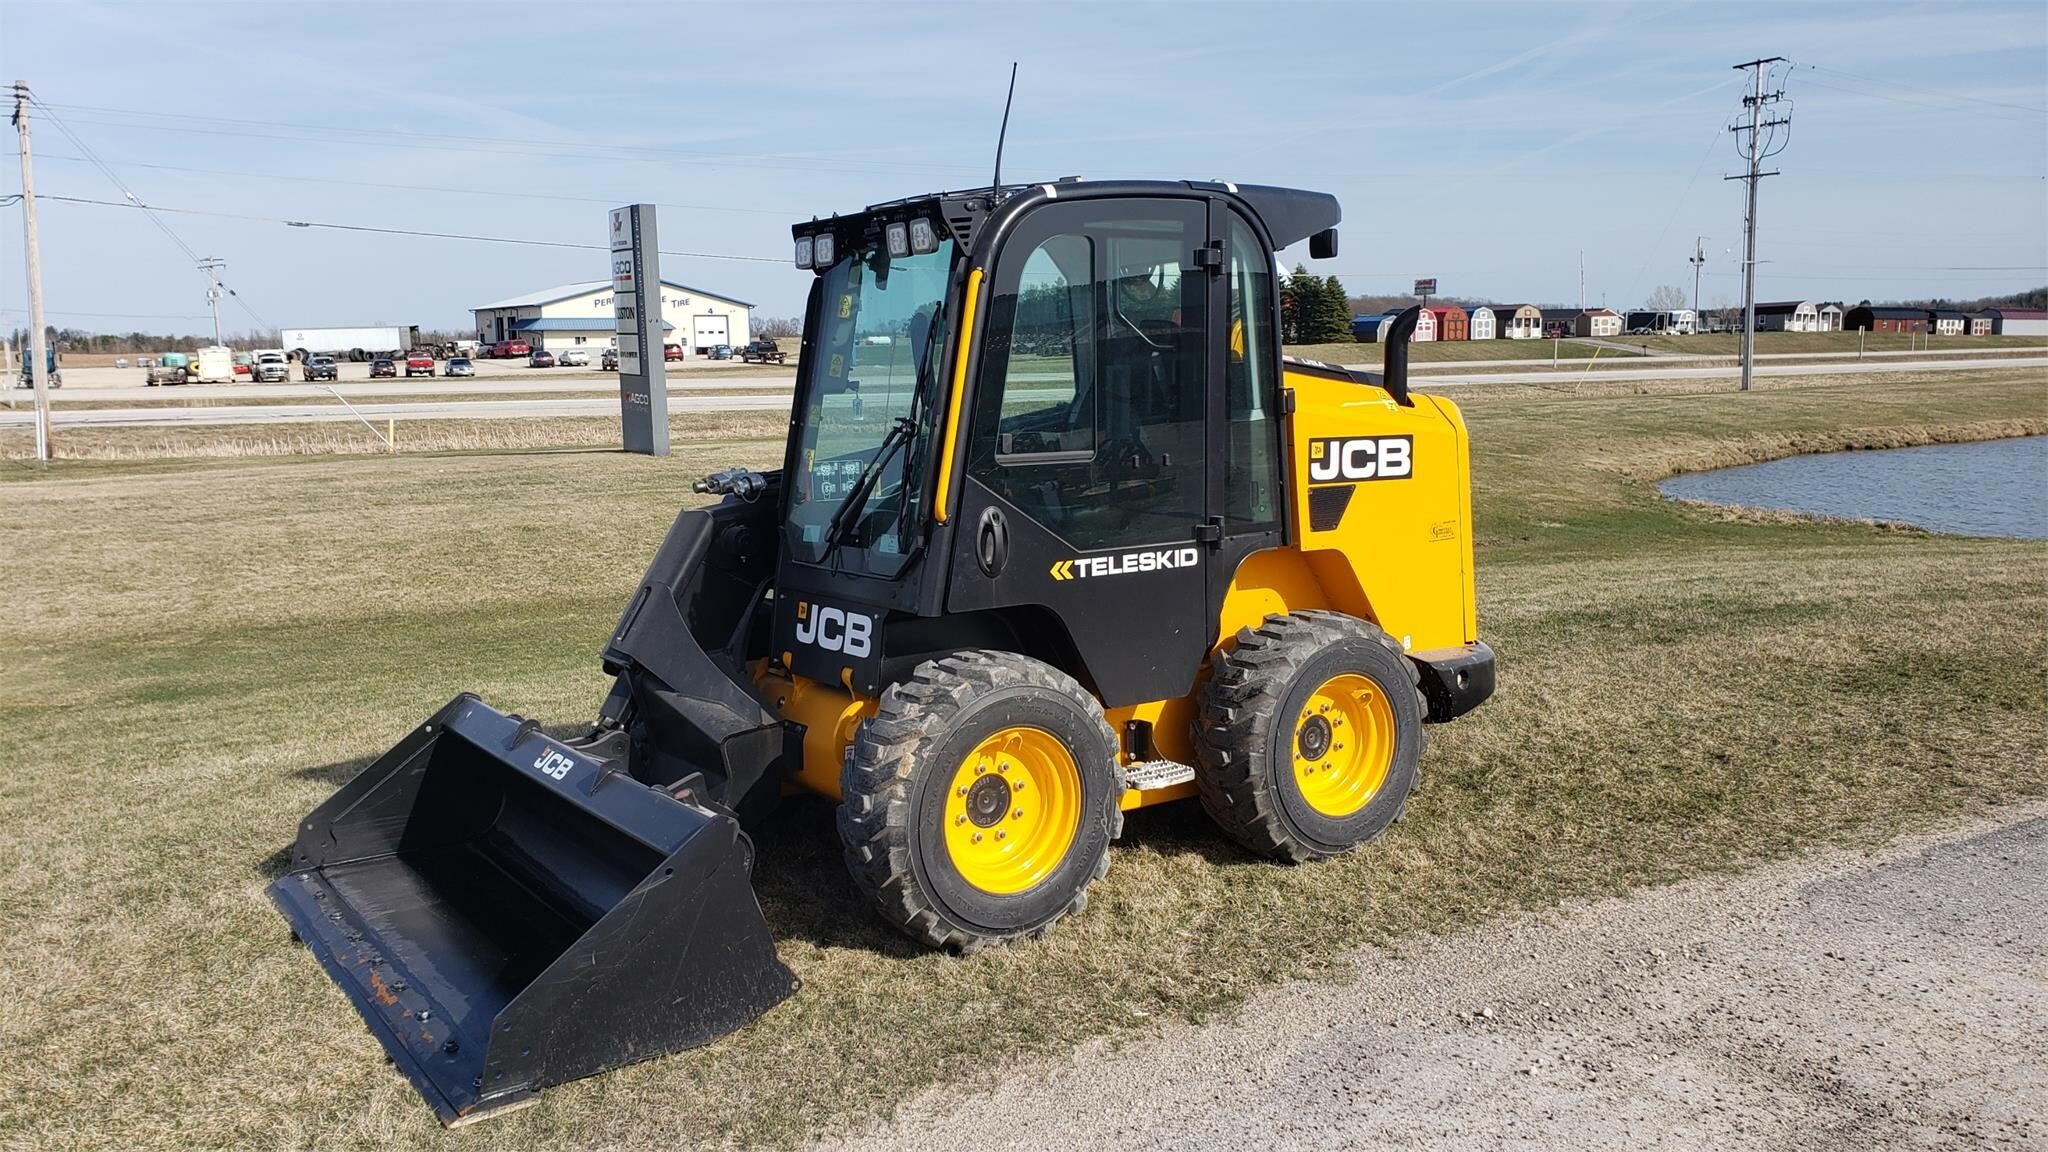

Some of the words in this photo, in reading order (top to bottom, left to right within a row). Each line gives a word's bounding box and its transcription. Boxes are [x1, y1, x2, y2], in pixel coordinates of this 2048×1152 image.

[671, 298, 691, 309] TIRE
[629, 392, 649, 405] AGCO
[1310, 438, 1412, 481] JCB
[1073, 547, 1199, 579] TELESKID
[796, 603, 873, 659] JCB
[533, 750, 575, 781] JCB
